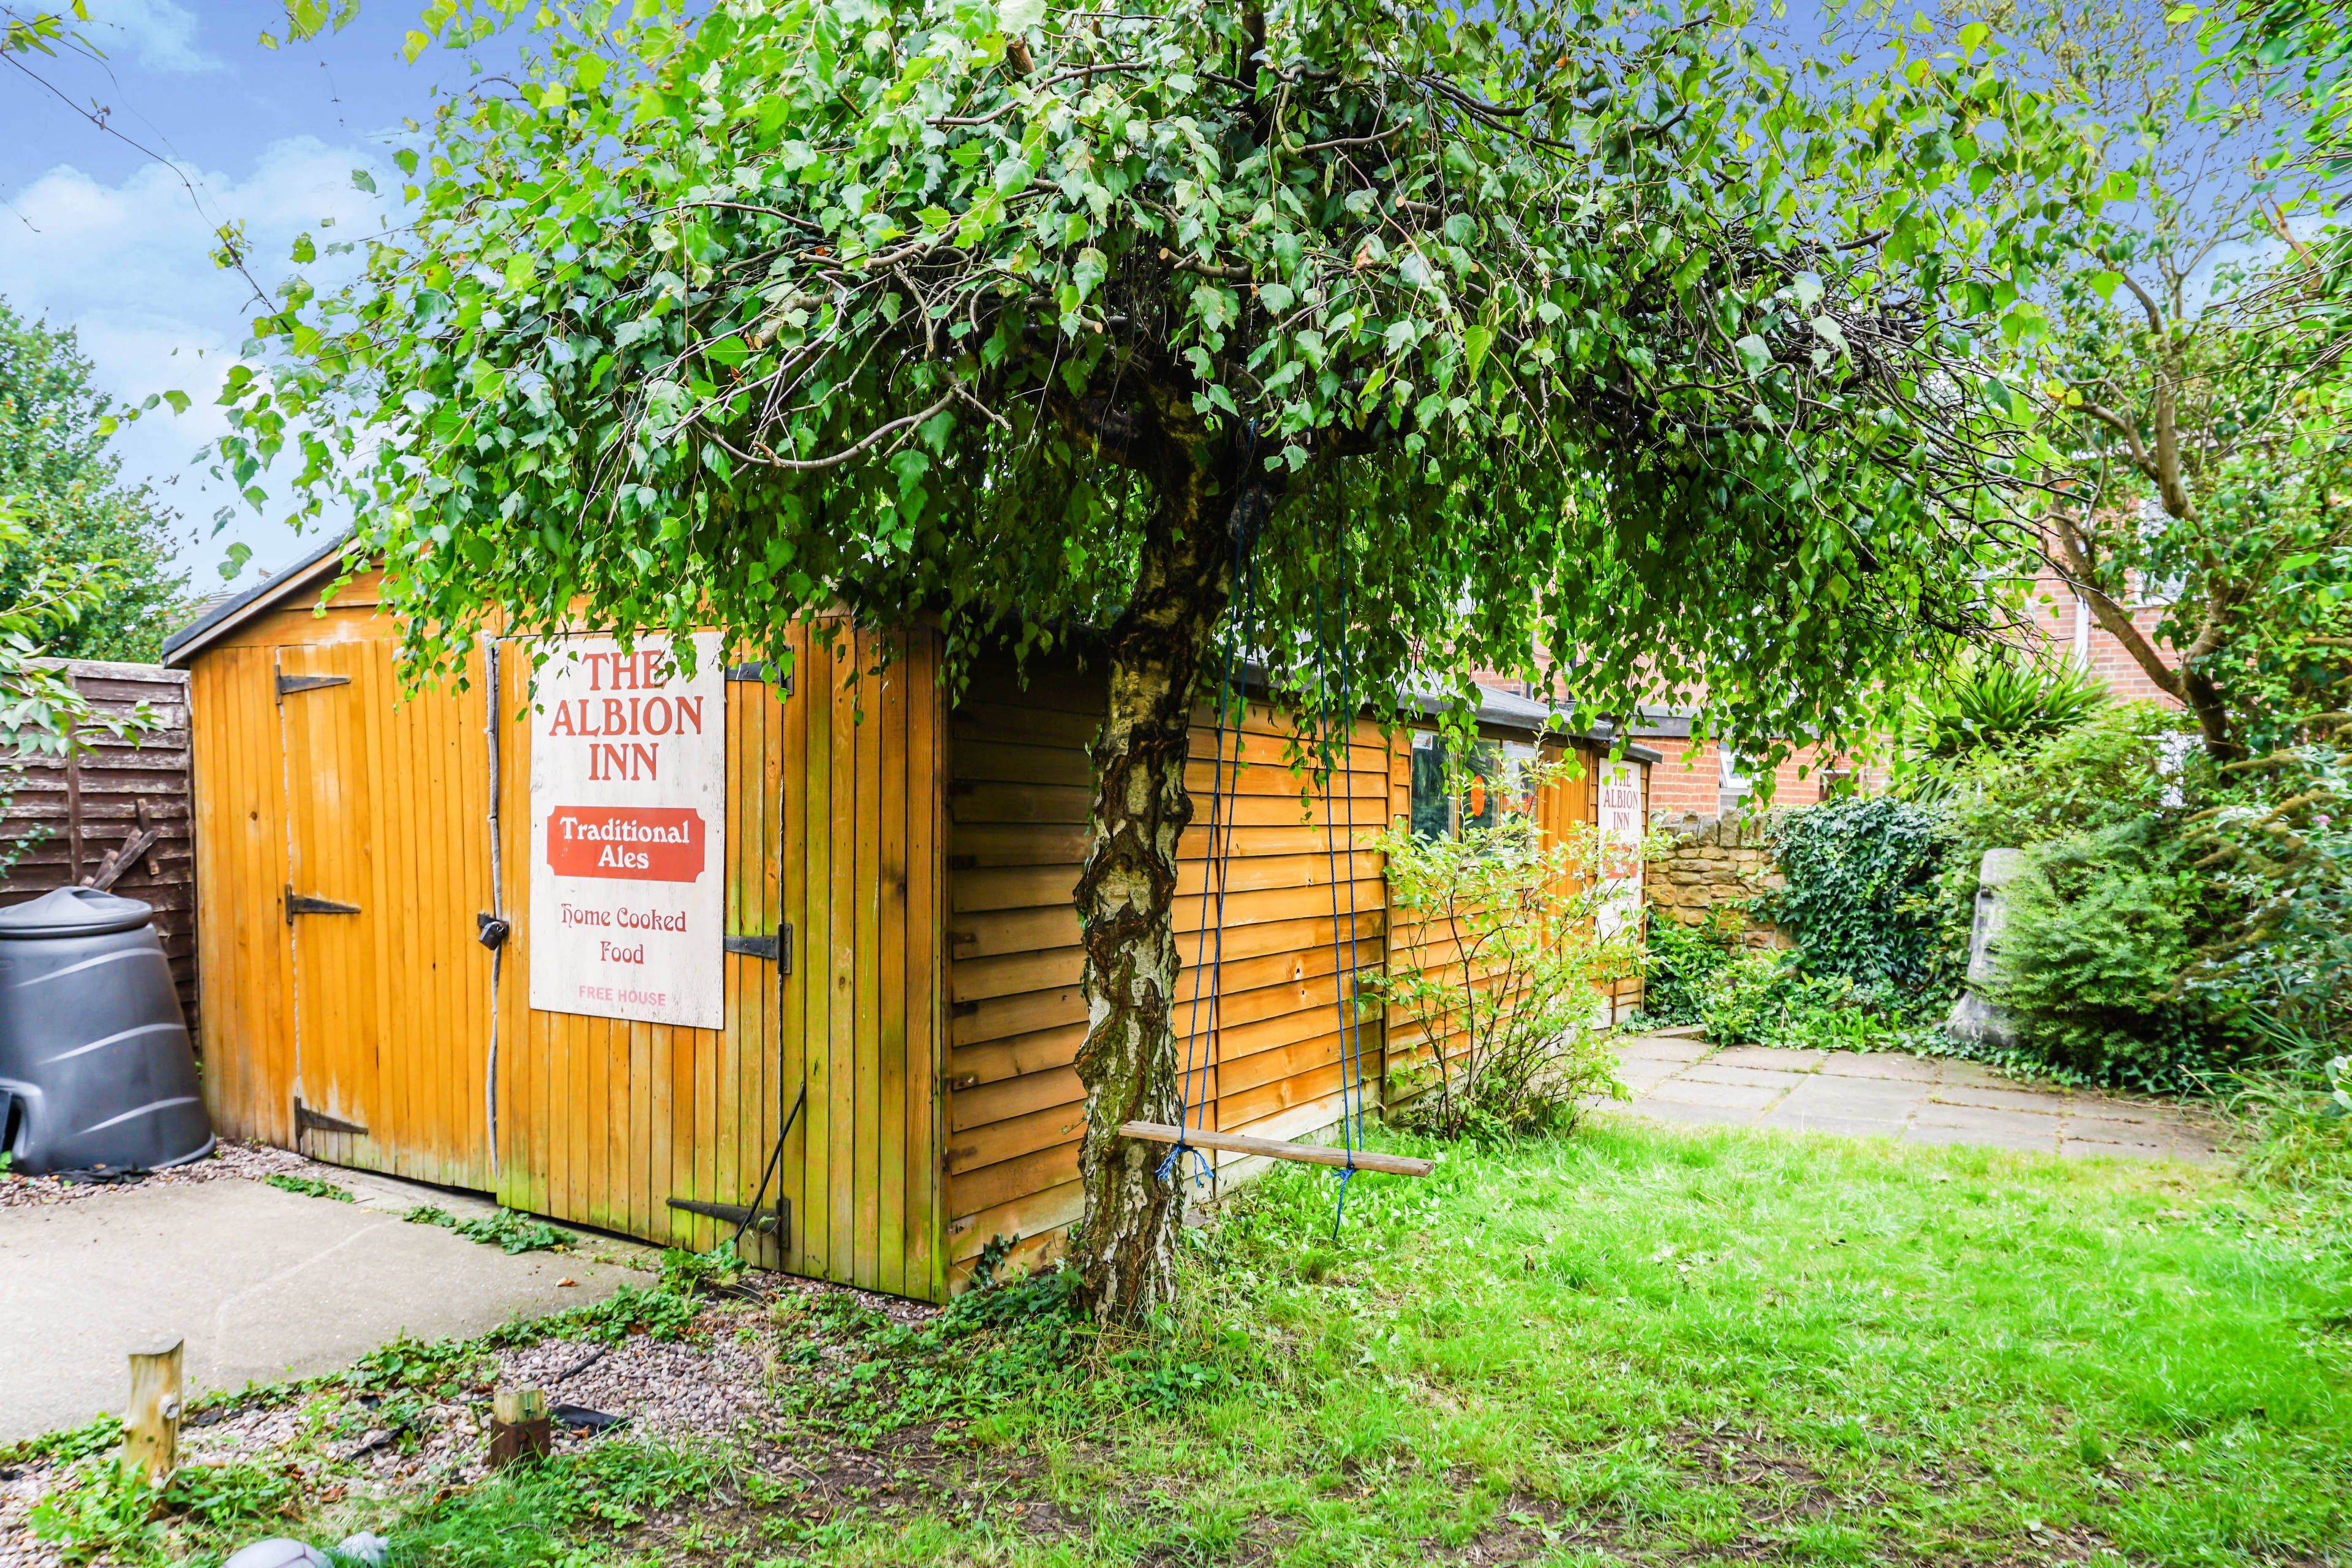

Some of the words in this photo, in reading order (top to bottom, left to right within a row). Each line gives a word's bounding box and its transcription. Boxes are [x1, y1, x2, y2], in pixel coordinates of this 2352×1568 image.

[581, 649, 669, 691] THE
[548, 696, 704, 737] ALBION
[588, 742, 660, 781] INN
[1604, 788, 1638, 809] ALBION
[559, 816, 690, 843] Traditional
[1613, 811, 1630, 831] INN
[597, 844, 649, 869] Ales
[560, 903, 611, 929] Home
[616, 907, 687, 932] Cooked
[600, 940, 644, 965] Food
[578, 985, 613, 1001] FREE
[617, 989, 666, 1007] HOUSE
